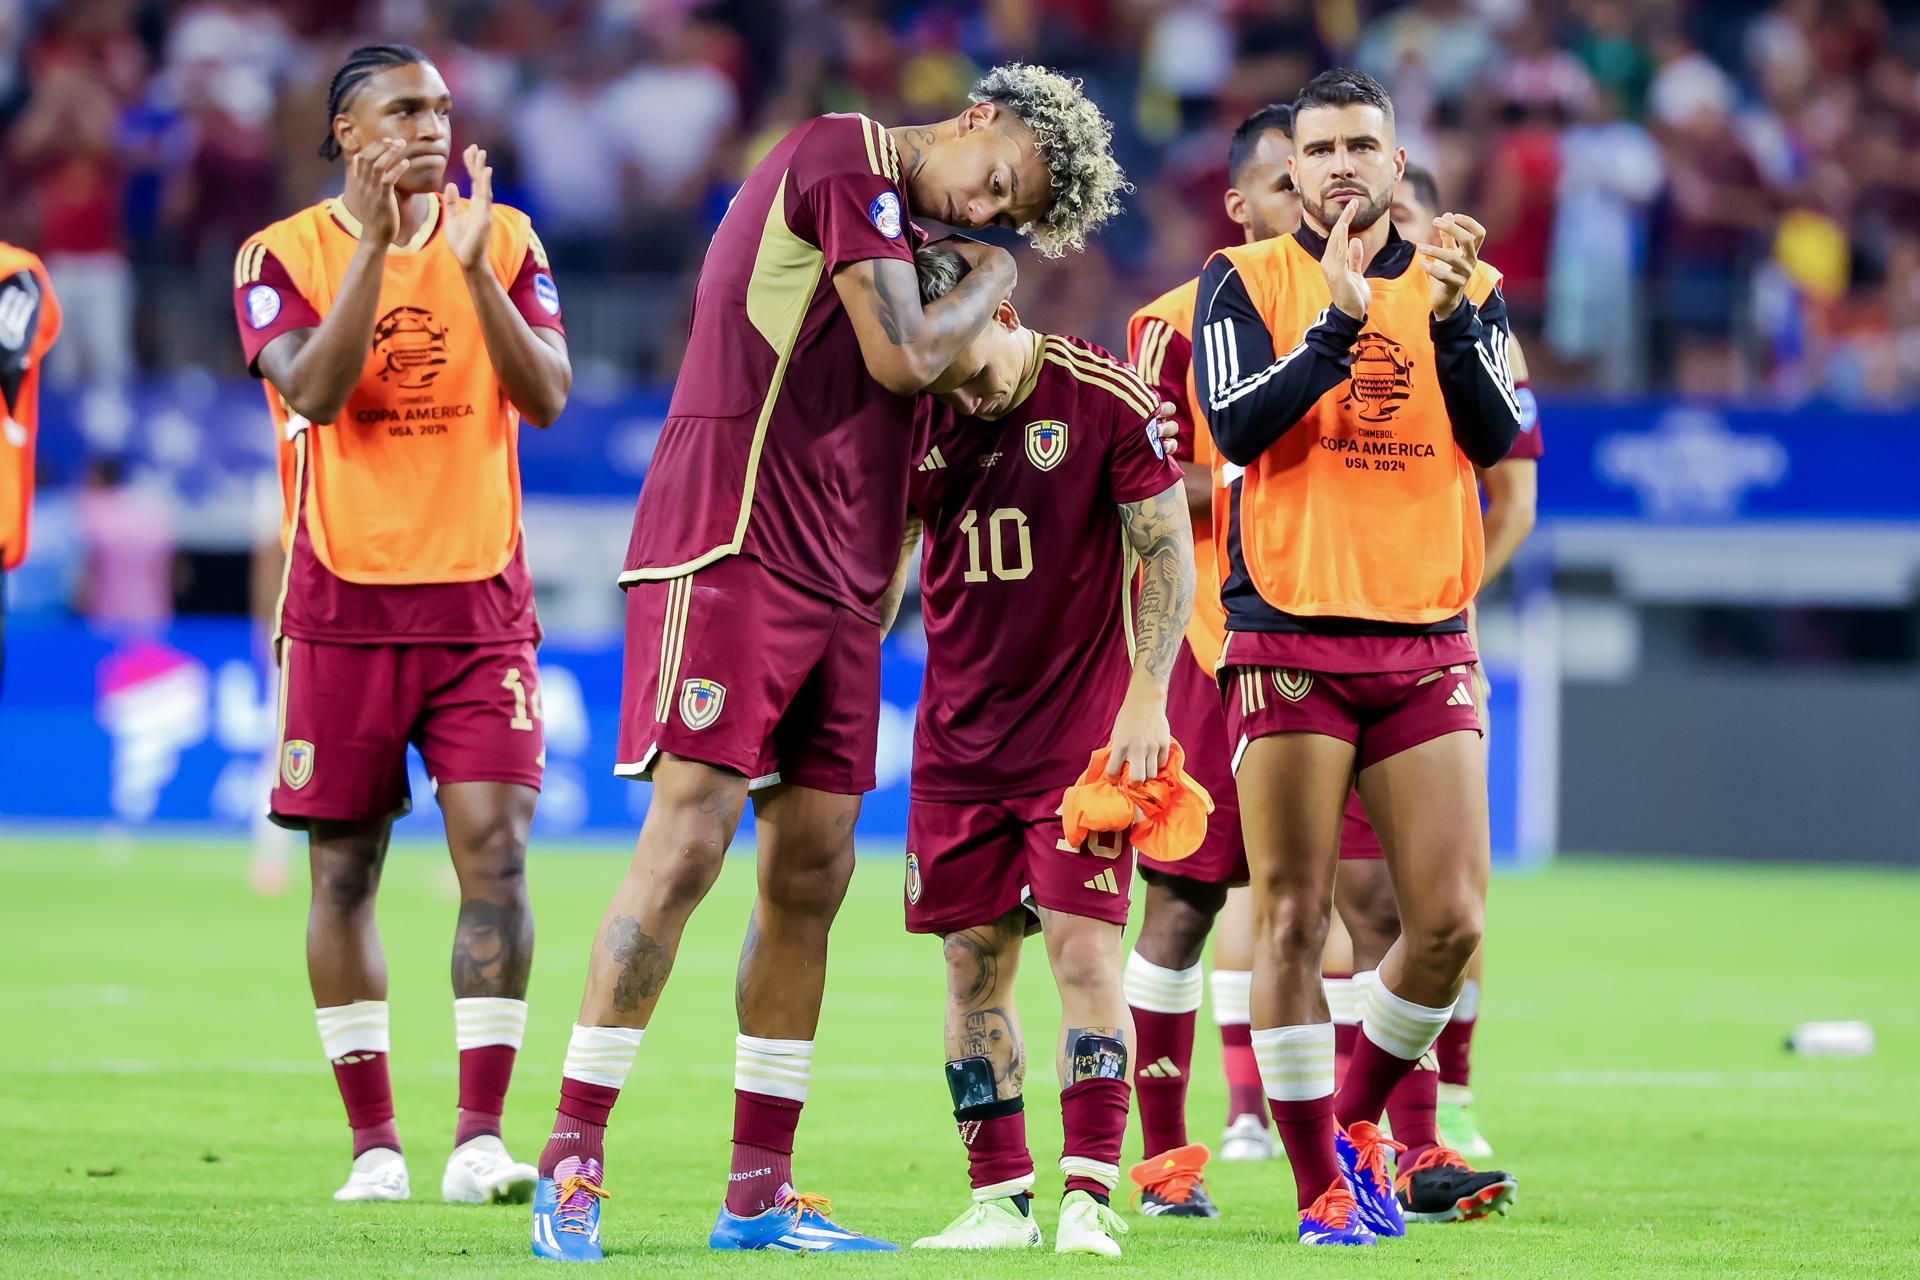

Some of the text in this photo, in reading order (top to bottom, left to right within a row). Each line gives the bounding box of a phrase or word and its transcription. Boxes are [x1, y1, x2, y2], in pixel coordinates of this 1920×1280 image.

[356, 405, 475, 424] COPA AMERICA
[388, 424, 449, 436] USA 2024
[1320, 436, 1435, 457] COPA AMERICA
[1345, 457, 1405, 472] USA 2024
[958, 507, 1034, 583] 10
